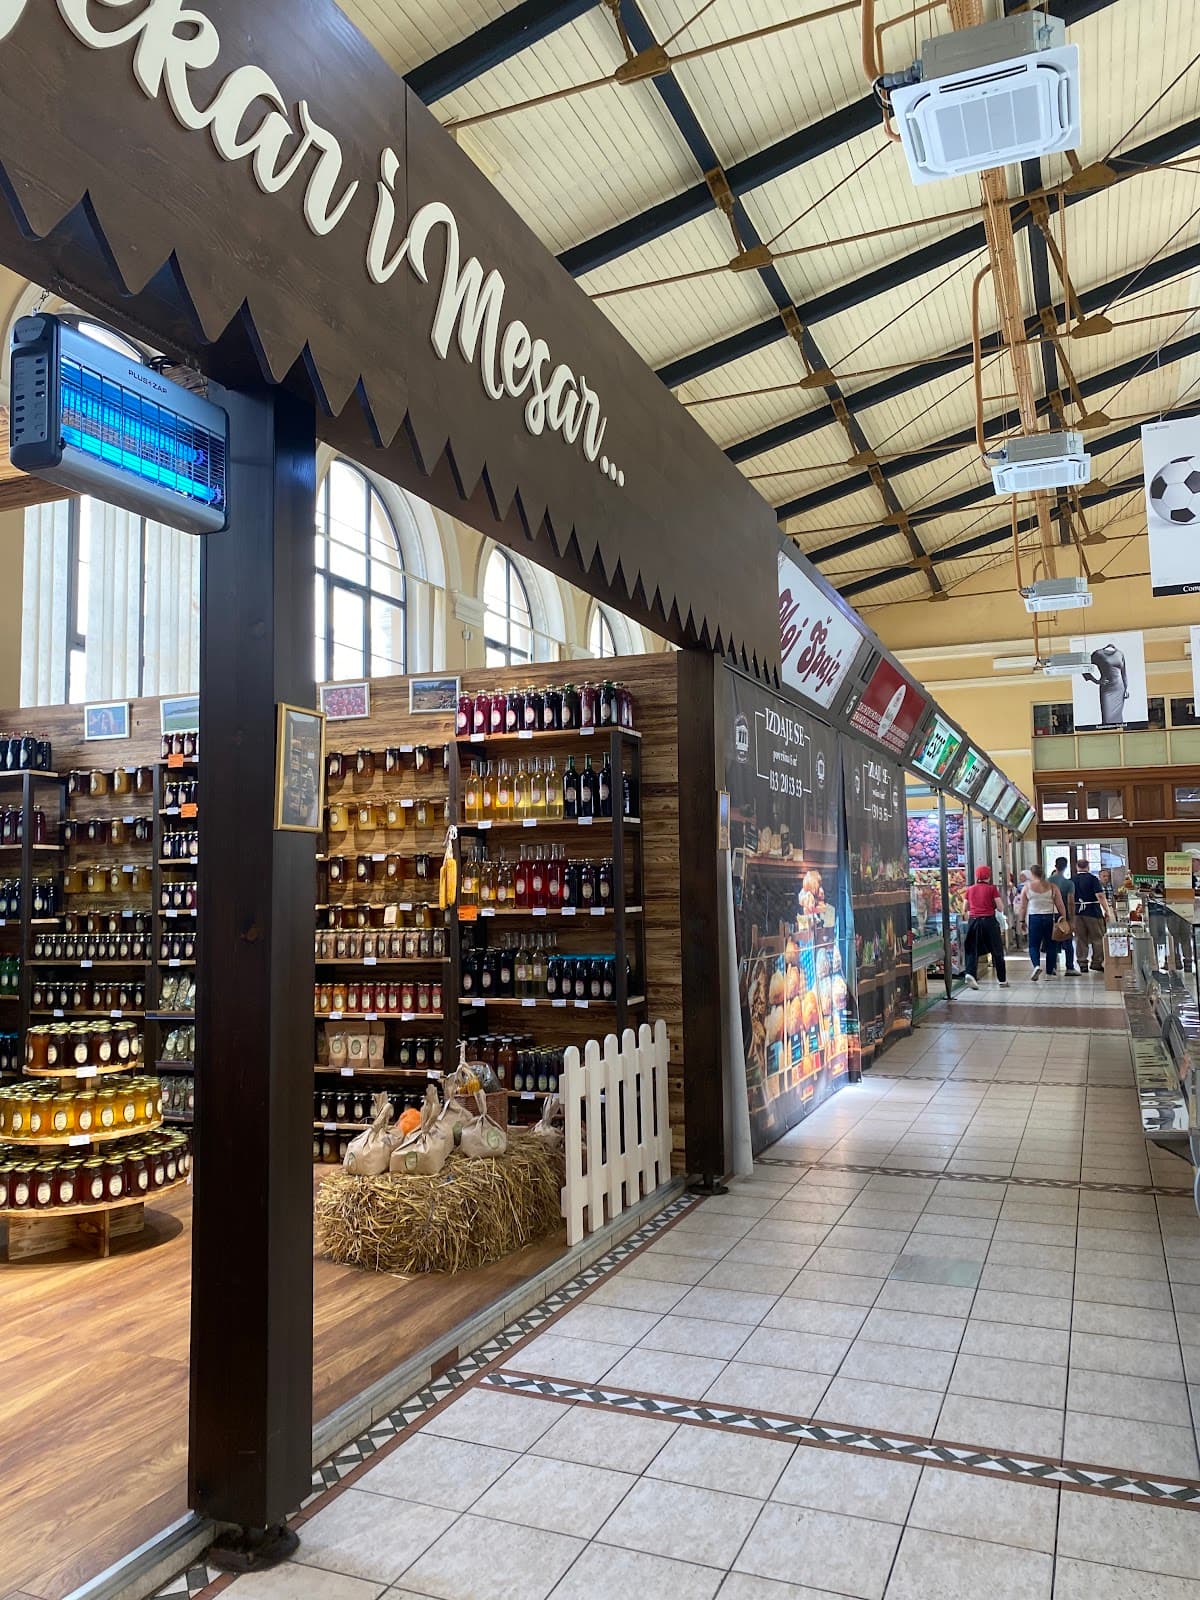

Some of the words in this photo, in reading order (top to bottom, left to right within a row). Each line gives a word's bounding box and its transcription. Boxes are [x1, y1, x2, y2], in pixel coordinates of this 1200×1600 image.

[366, 147, 410, 284] i
[797, 616, 842, 693] Špajz
[764, 707, 794, 746] IZDAJE
[793, 723, 805, 747] SE
